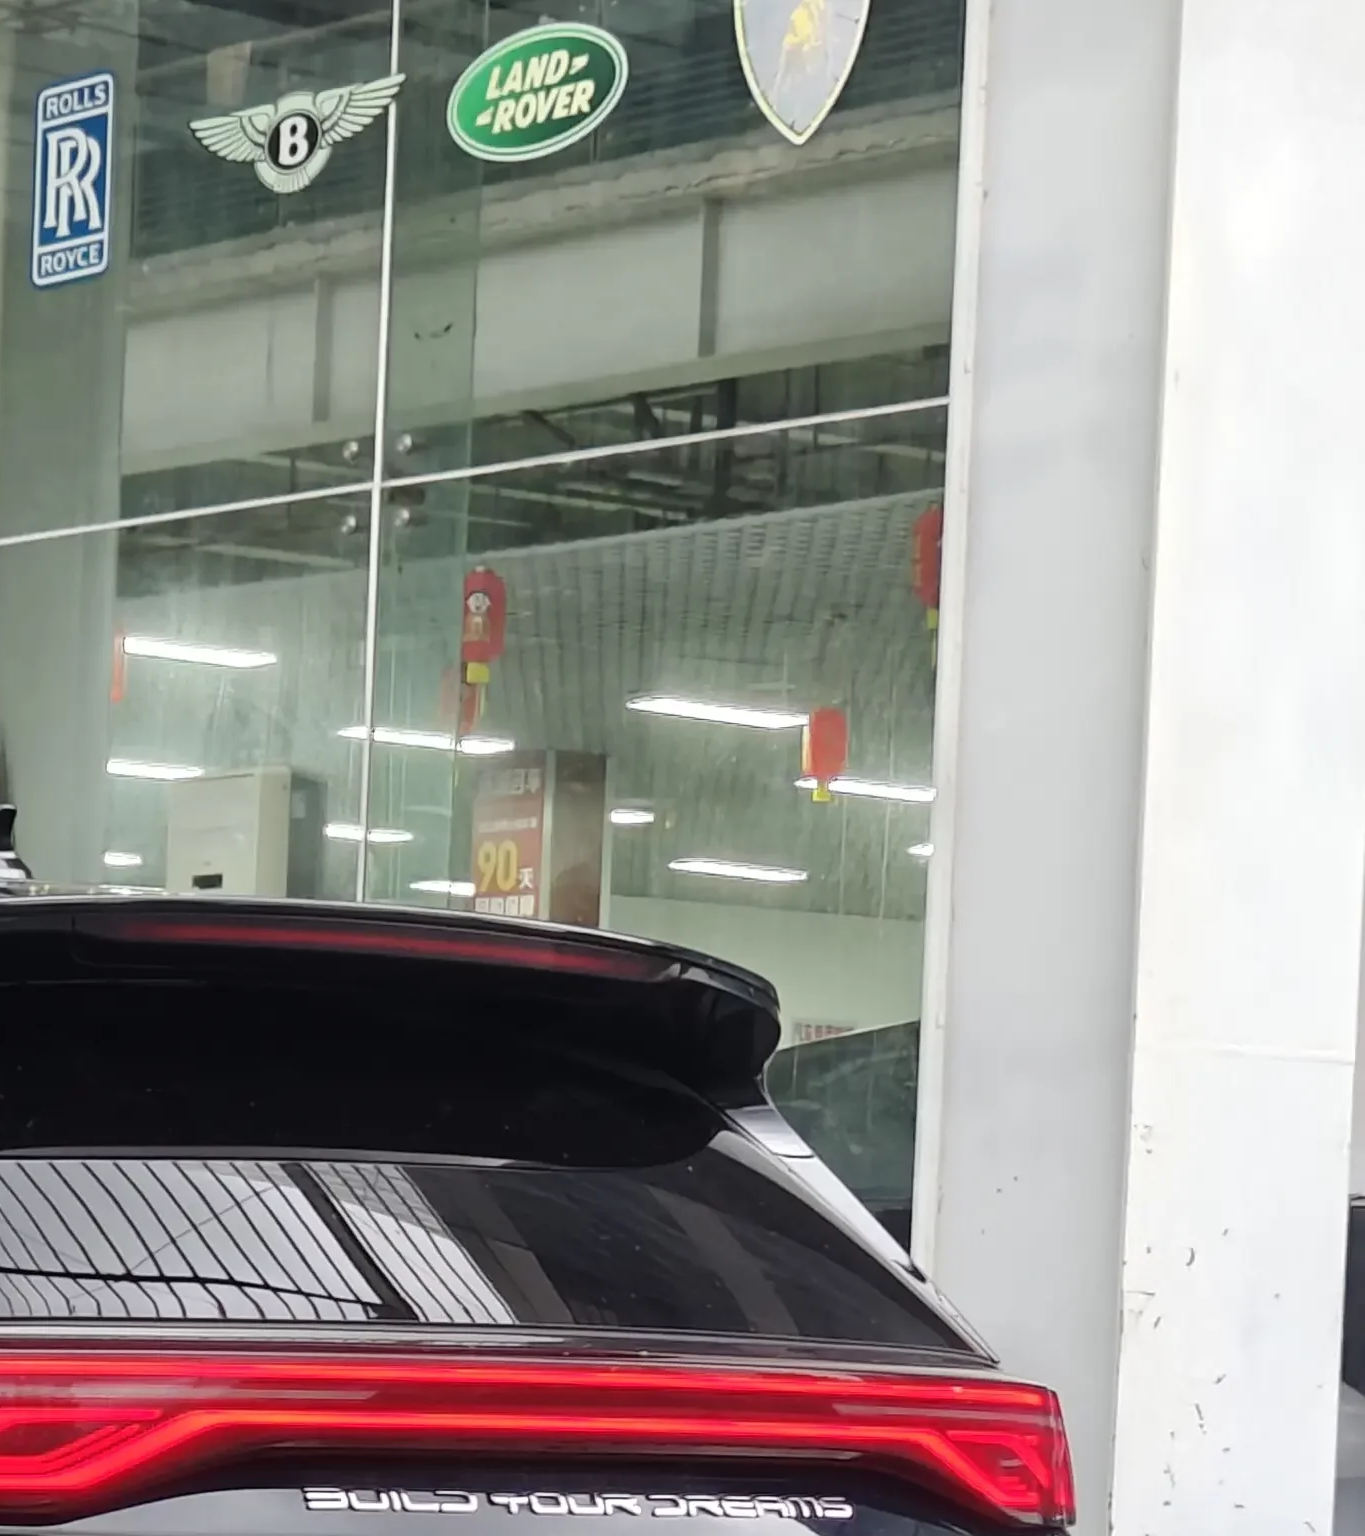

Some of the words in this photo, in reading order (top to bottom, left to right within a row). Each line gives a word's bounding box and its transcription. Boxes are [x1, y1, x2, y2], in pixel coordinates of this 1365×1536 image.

[45, 83, 107, 119] ROLLS
[278, 115, 310, 166] B
[40, 243, 102, 277] ROYCE
[303, 1487, 479, 1513] BUILD
[488, 1491, 642, 1516] YOUR
[648, 1494, 855, 1519] DREAMS
